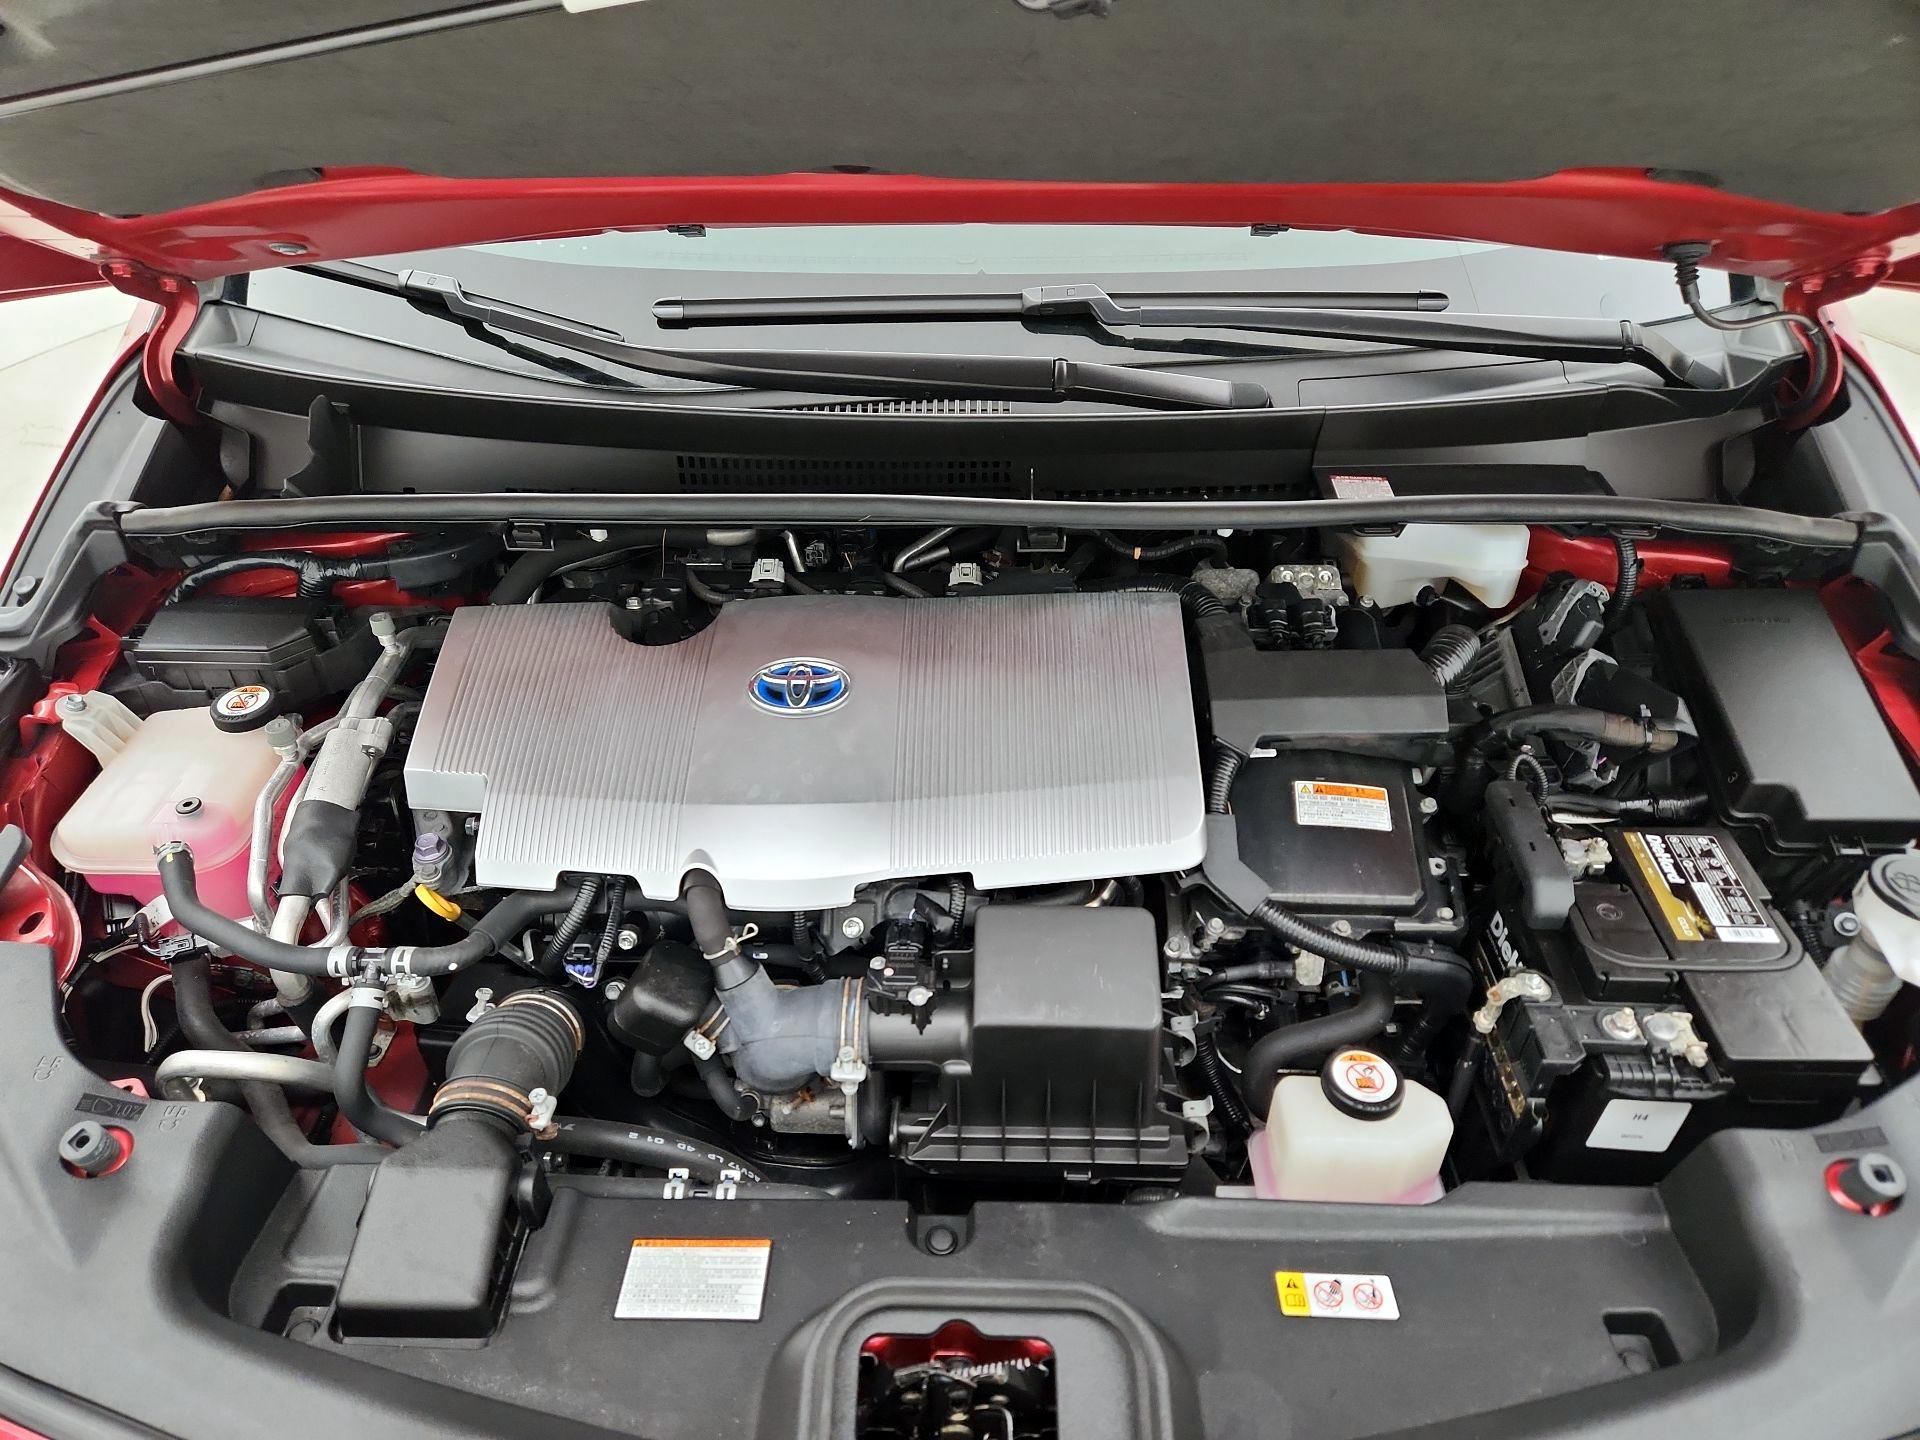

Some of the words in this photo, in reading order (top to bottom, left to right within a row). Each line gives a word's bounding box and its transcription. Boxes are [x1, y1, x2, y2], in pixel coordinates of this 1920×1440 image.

[1645, 834, 1686, 885] DieHard
[1490, 910, 1524, 968] DieH
[1677, 916, 1694, 937] GOLD
